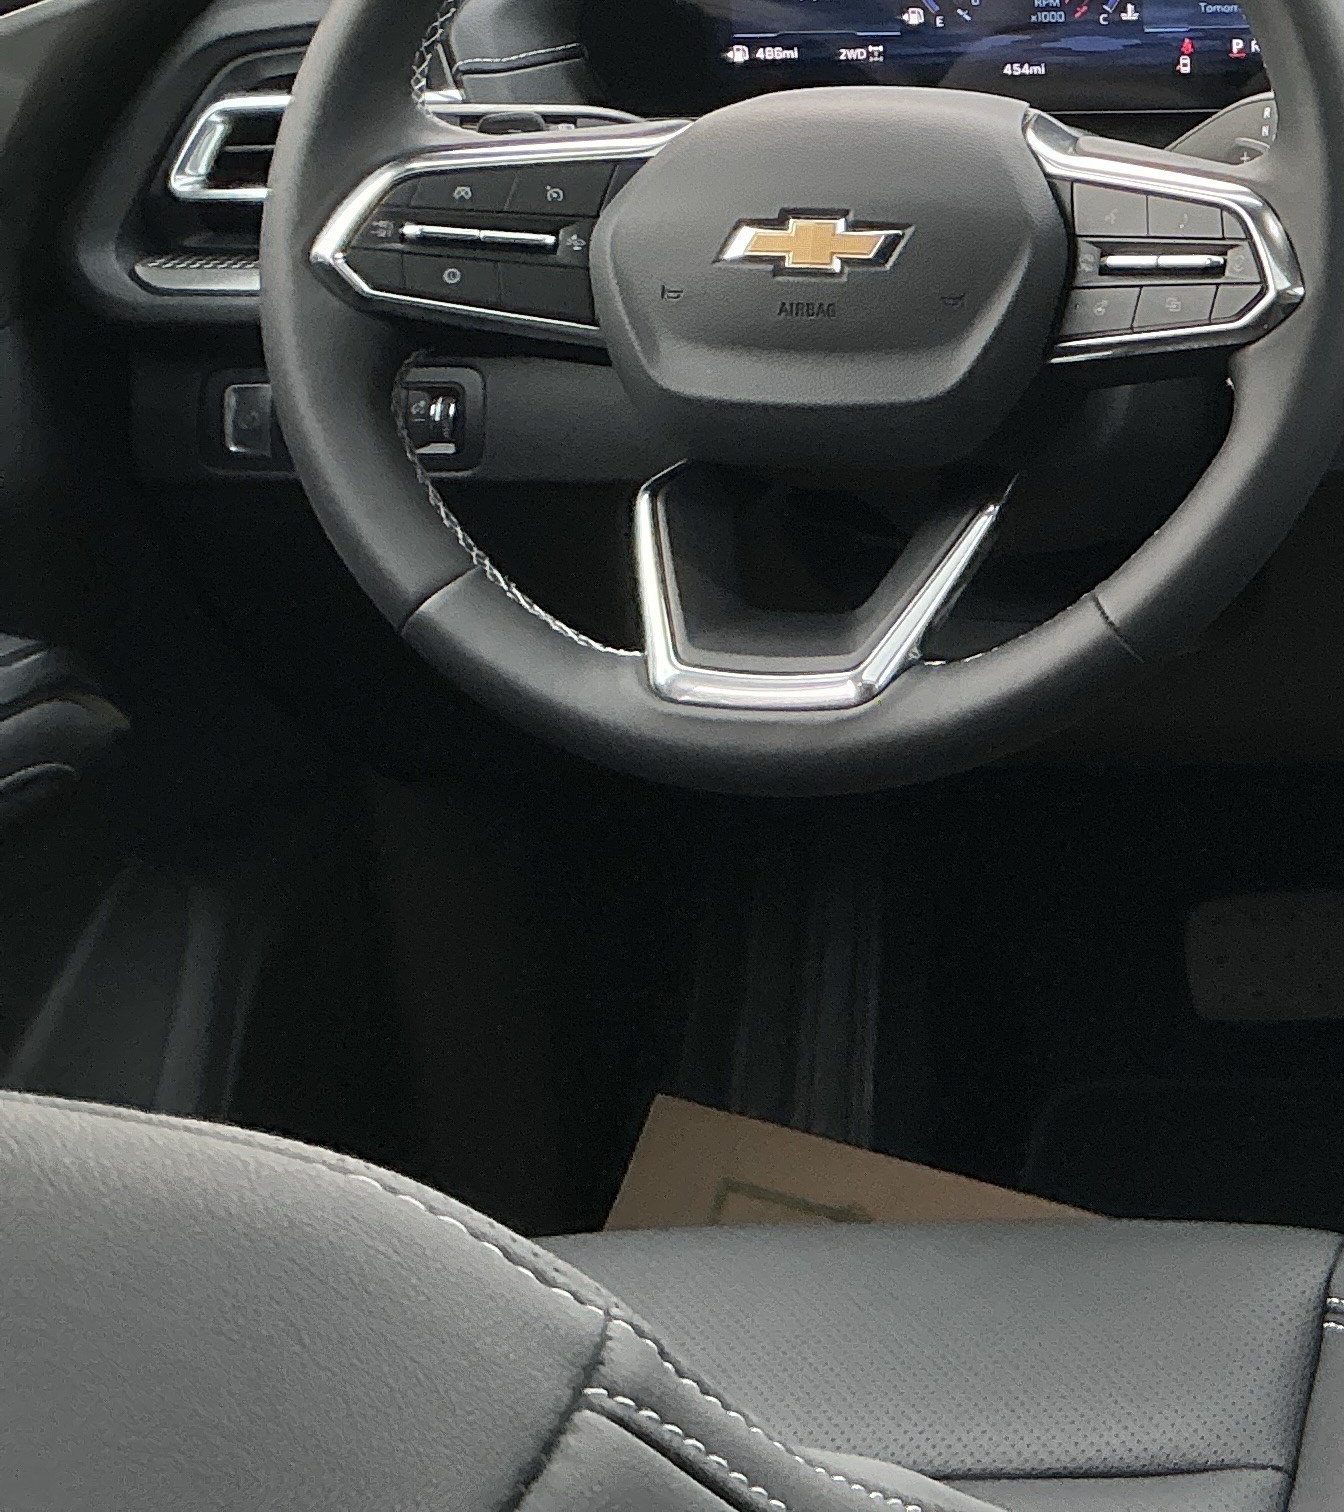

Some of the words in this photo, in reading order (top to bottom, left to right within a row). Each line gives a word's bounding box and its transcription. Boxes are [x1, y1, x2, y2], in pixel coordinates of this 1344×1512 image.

[935, 15, 945, 28] E
[1030, 11, 1066, 23] x1000
[1098, 13, 1110, 26] C
[1231, 38, 1245, 54] P
[838, 48, 867, 61] 2WD
[1002, 63, 1047, 76] 454mi
[777, 301, 837, 318] AIRBAG
